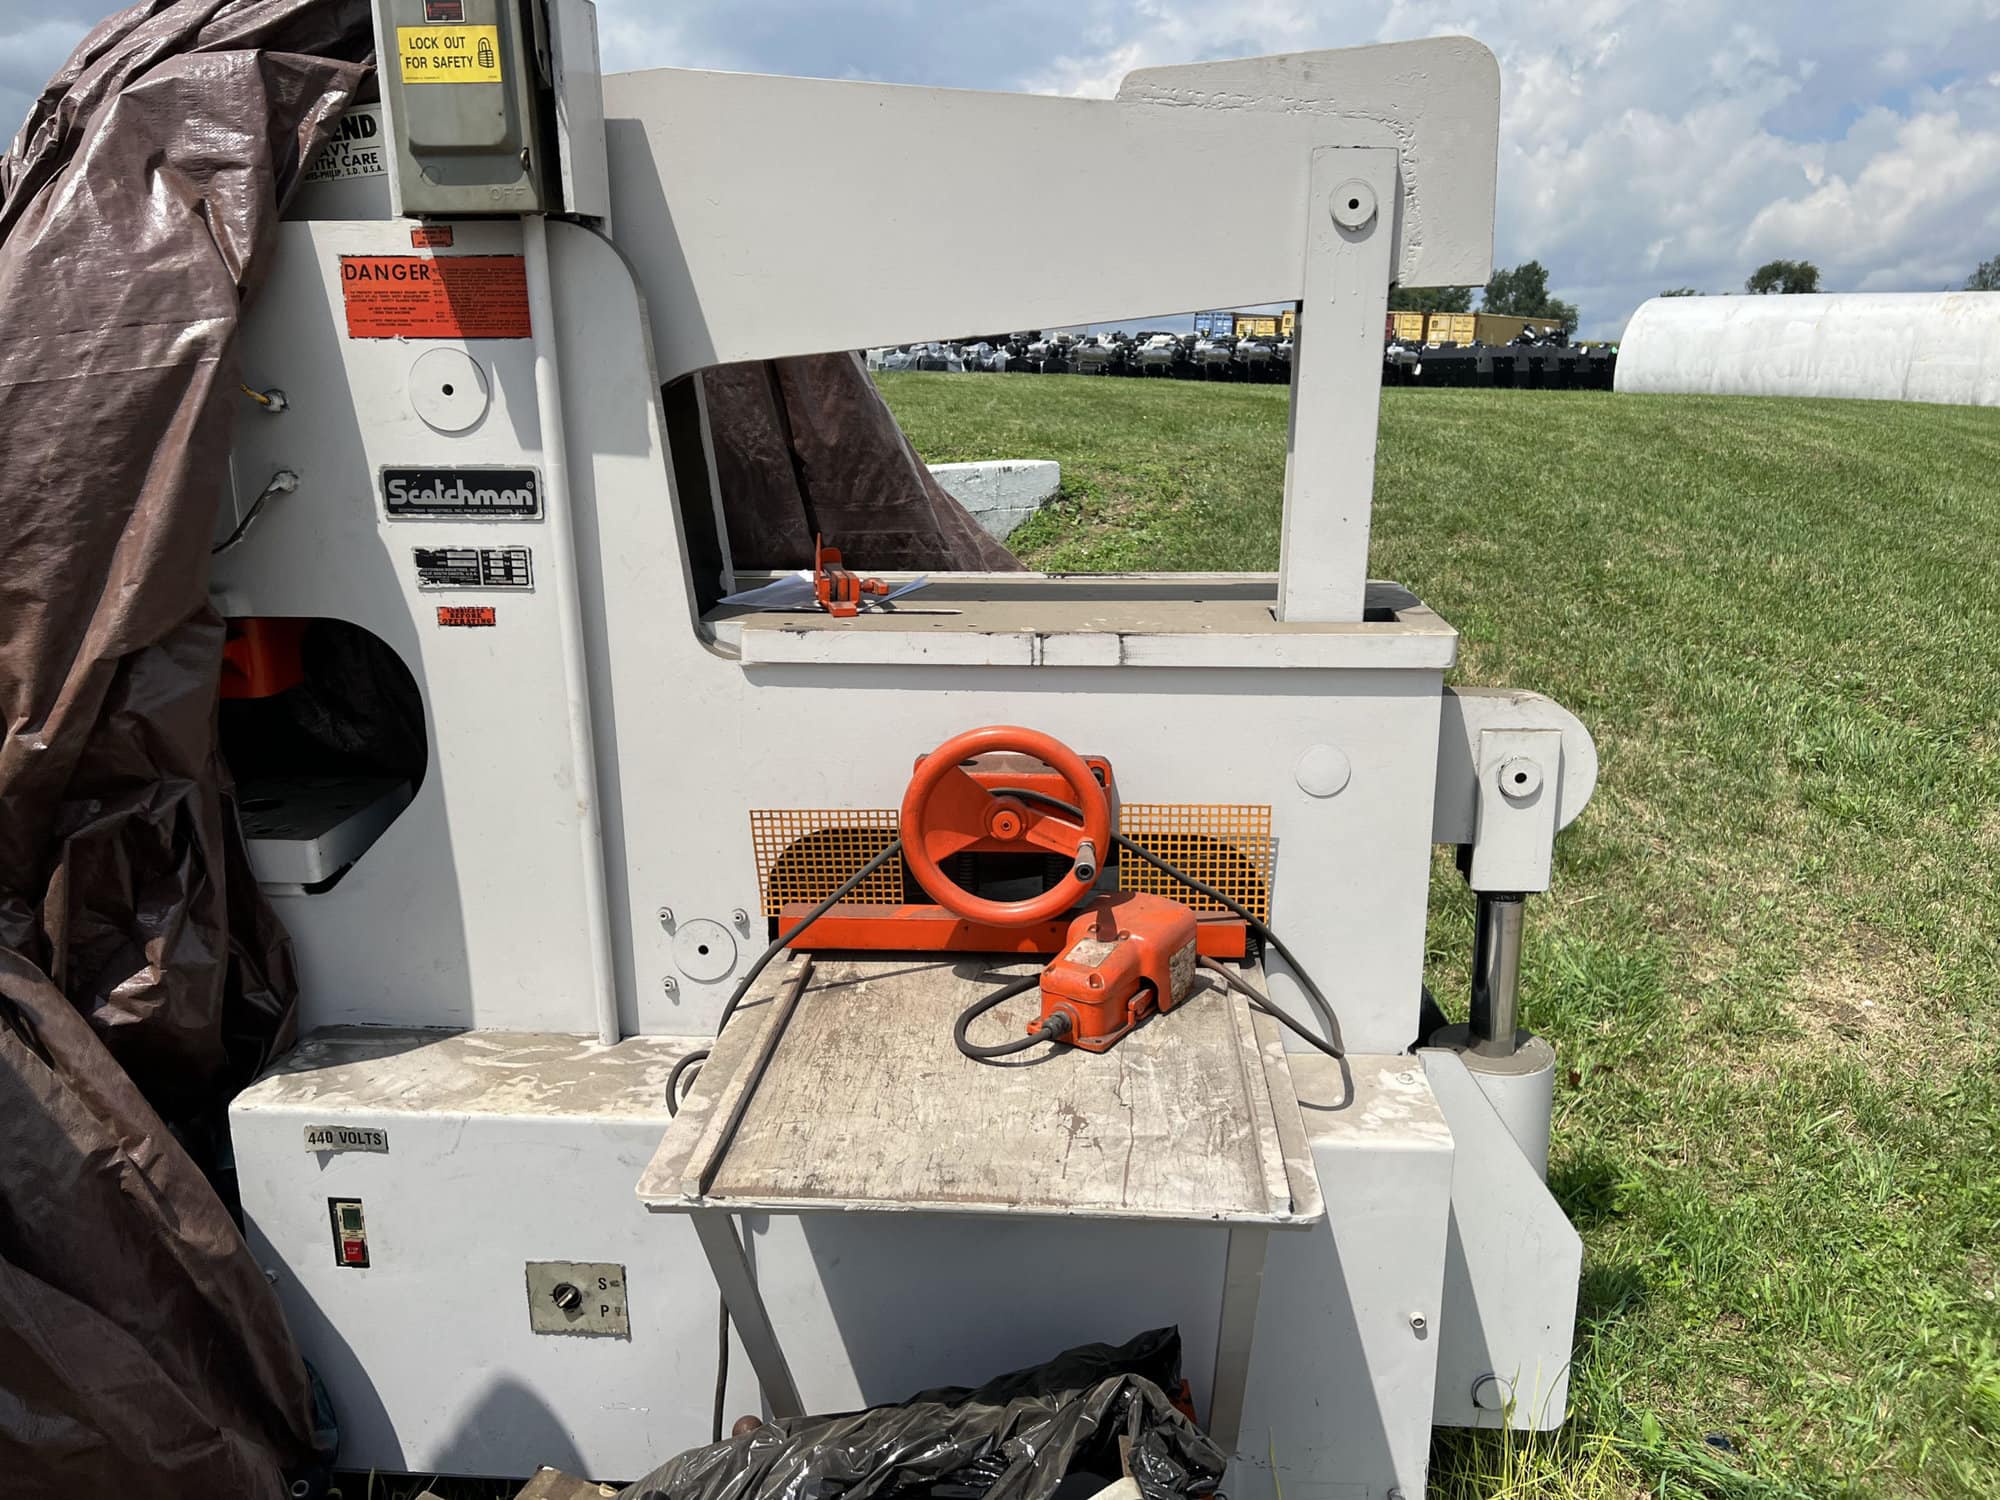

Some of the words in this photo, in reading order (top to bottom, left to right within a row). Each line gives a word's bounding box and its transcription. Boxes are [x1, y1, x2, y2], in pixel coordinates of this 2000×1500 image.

[408, 37, 439, 50] LOCK
[444, 36, 466, 49] OUT
[406, 56, 427, 69] FOR
[433, 56, 473, 69] SAFETY
[341, 152, 378, 167] CARE
[488, 186, 529, 201] OFF
[344, 263, 431, 281] DANGER
[388, 478, 534, 505] Scotchman
[308, 1131, 333, 1145] 440
[339, 1131, 382, 1146] VOLTS
[598, 1277, 607, 1290] S
[600, 1304, 609, 1318] P
